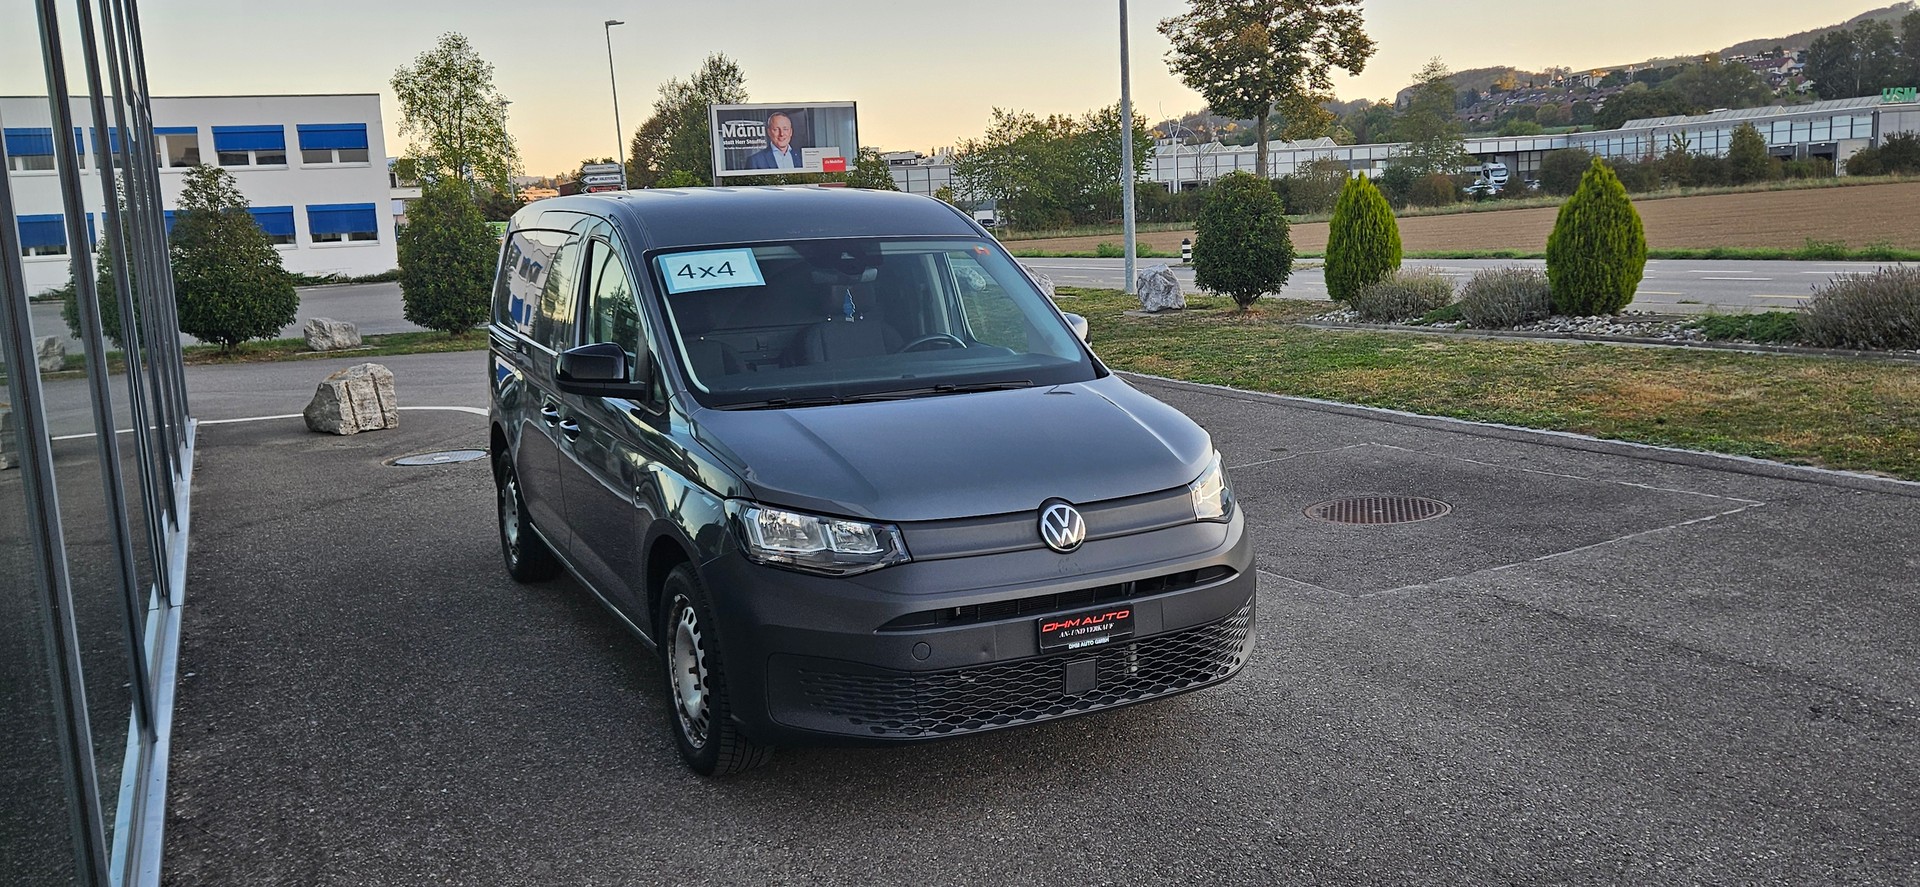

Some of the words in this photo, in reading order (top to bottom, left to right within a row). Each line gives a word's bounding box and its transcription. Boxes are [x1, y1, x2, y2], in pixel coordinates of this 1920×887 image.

[1882, 87, 1917, 102] USM
[721, 123, 766, 138] Mänu
[677, 261, 736, 279] 4x4
[1042, 619, 1081, 632] OHM
[1082, 610, 1130, 625] AUTO
[1080, 639, 1094, 648] AUTO
